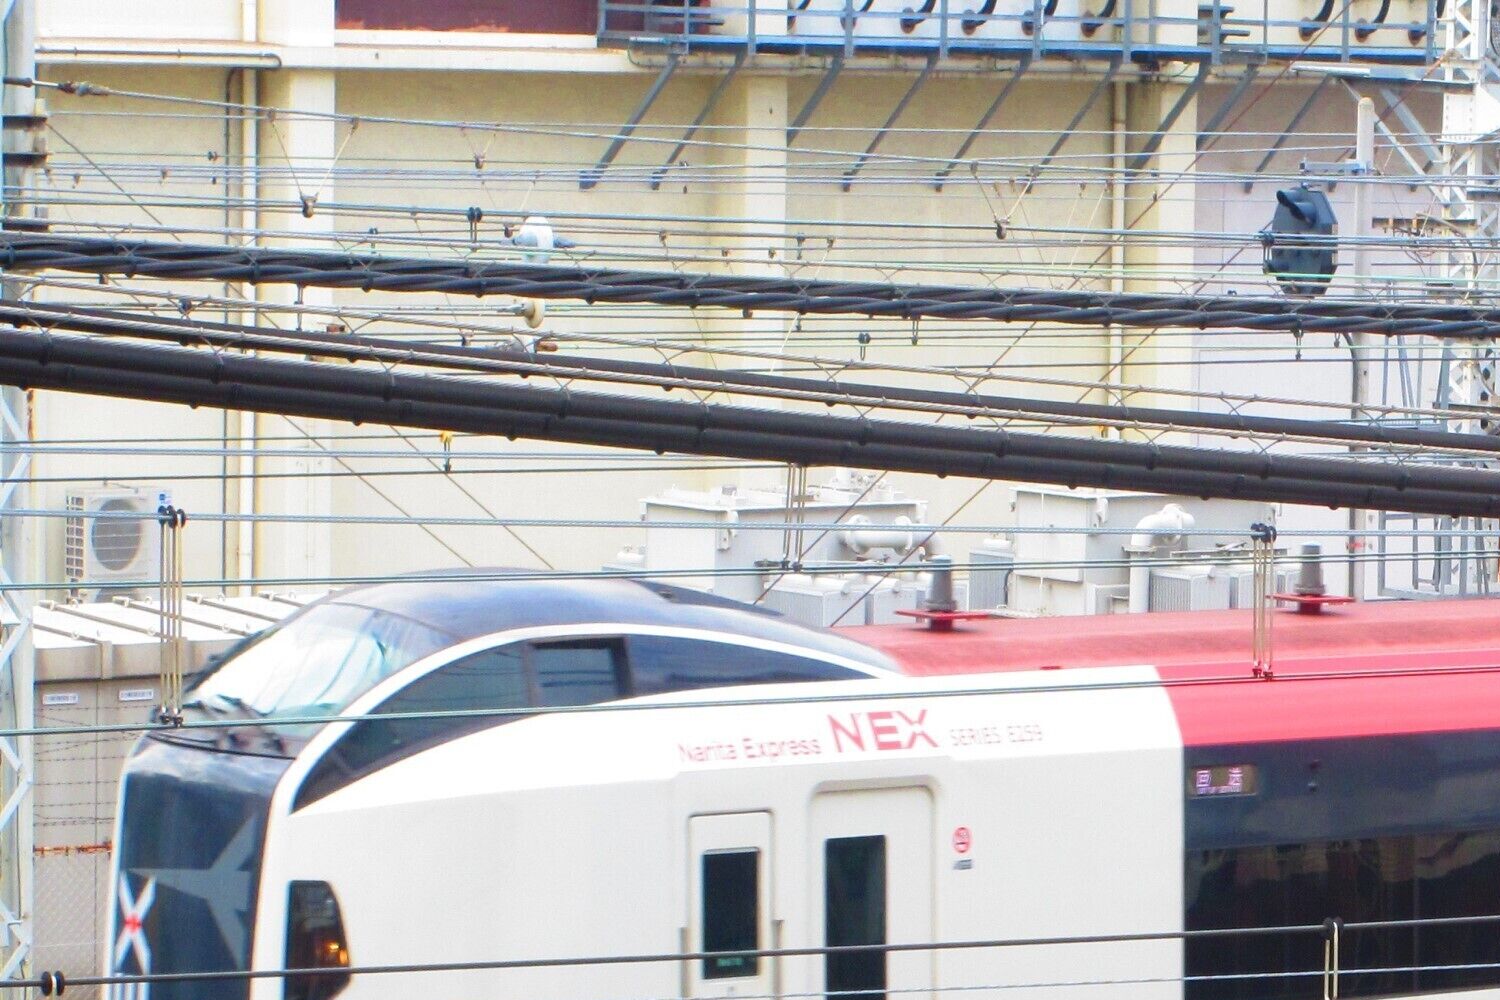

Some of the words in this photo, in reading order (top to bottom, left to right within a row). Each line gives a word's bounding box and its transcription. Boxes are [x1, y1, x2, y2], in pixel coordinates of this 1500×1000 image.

[677, 739, 738, 763] Narita
[743, 735, 821, 760] Express
[827, 709, 939, 753] NEX
